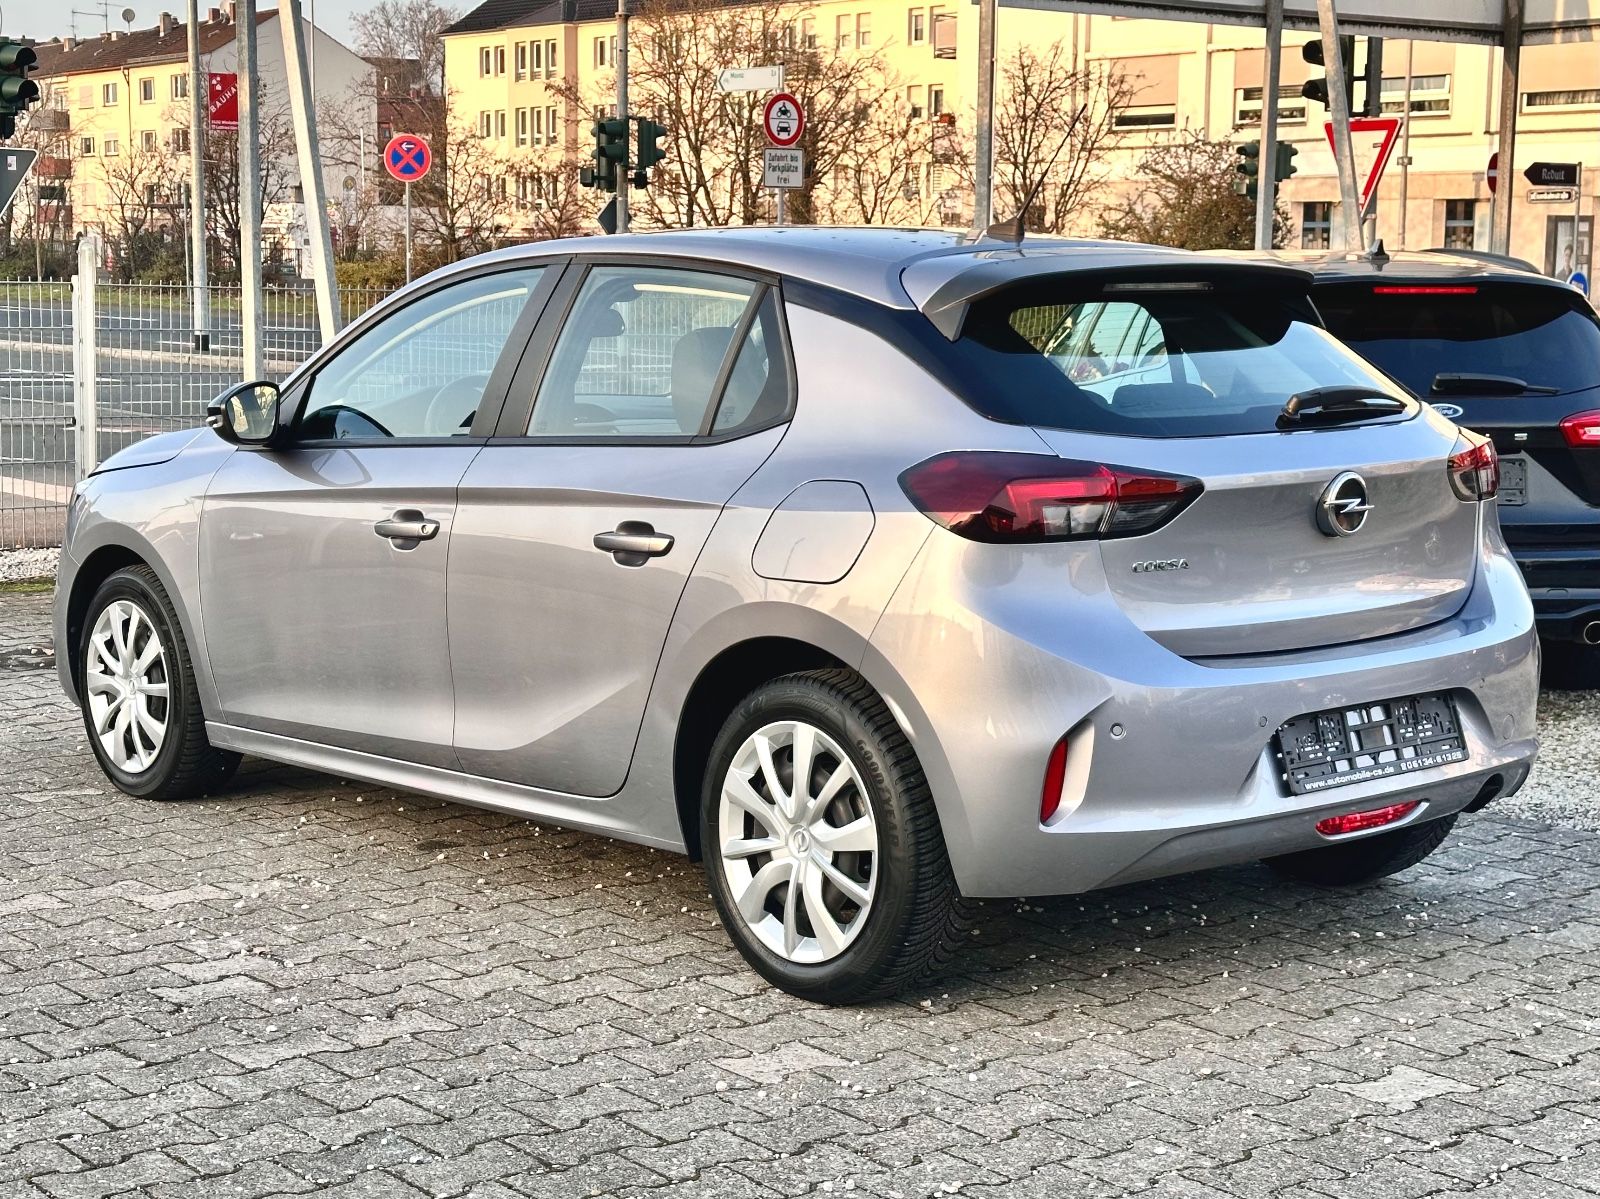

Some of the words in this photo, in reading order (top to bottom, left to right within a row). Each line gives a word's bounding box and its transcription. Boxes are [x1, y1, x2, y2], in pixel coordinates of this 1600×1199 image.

[209, 84, 238, 113] BAUHA
[768, 152, 788, 162] Zufahrt
[790, 153, 799, 162] bis
[768, 162, 799, 174] Parkplätze
[1542, 168, 1565, 180] Reduit
[777, 175, 790, 184] frei
[1132, 558, 1189, 573] CORSA
[1304, 765, 1395, 791] www.automobile-cs.de
